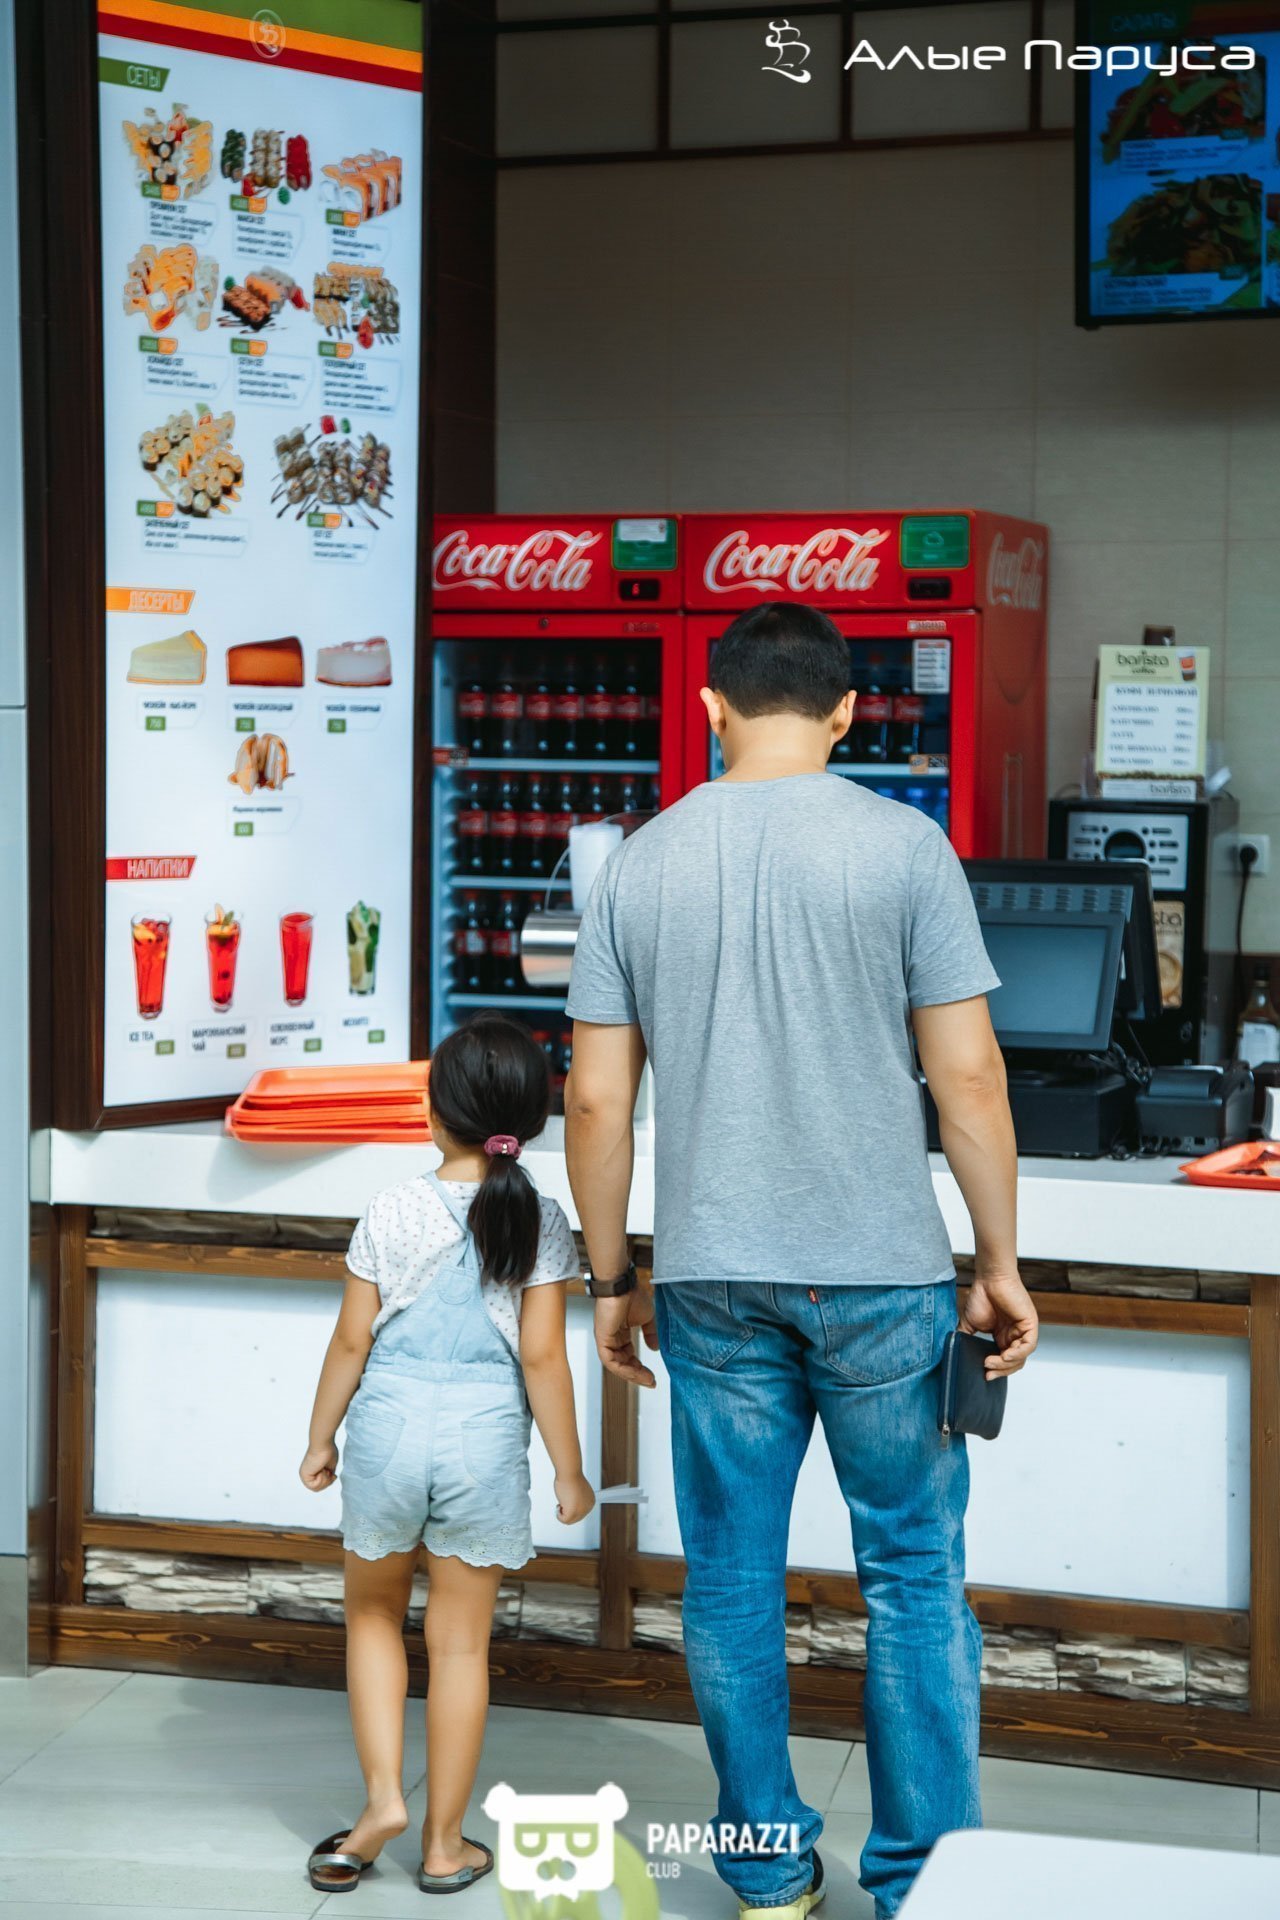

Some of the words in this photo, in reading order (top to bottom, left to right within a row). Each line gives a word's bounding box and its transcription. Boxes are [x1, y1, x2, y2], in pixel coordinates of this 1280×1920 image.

[126, 66, 162, 87] СЕТЫ
[432, 529, 603, 591] Coca-Cola
[703, 528, 891, 593] Coca-Cola
[128, 591, 185, 612] ДЕСЕРТЫ
[1117, 650, 1169, 666] barista
[127, 858, 189, 879] НАПИТКИ
